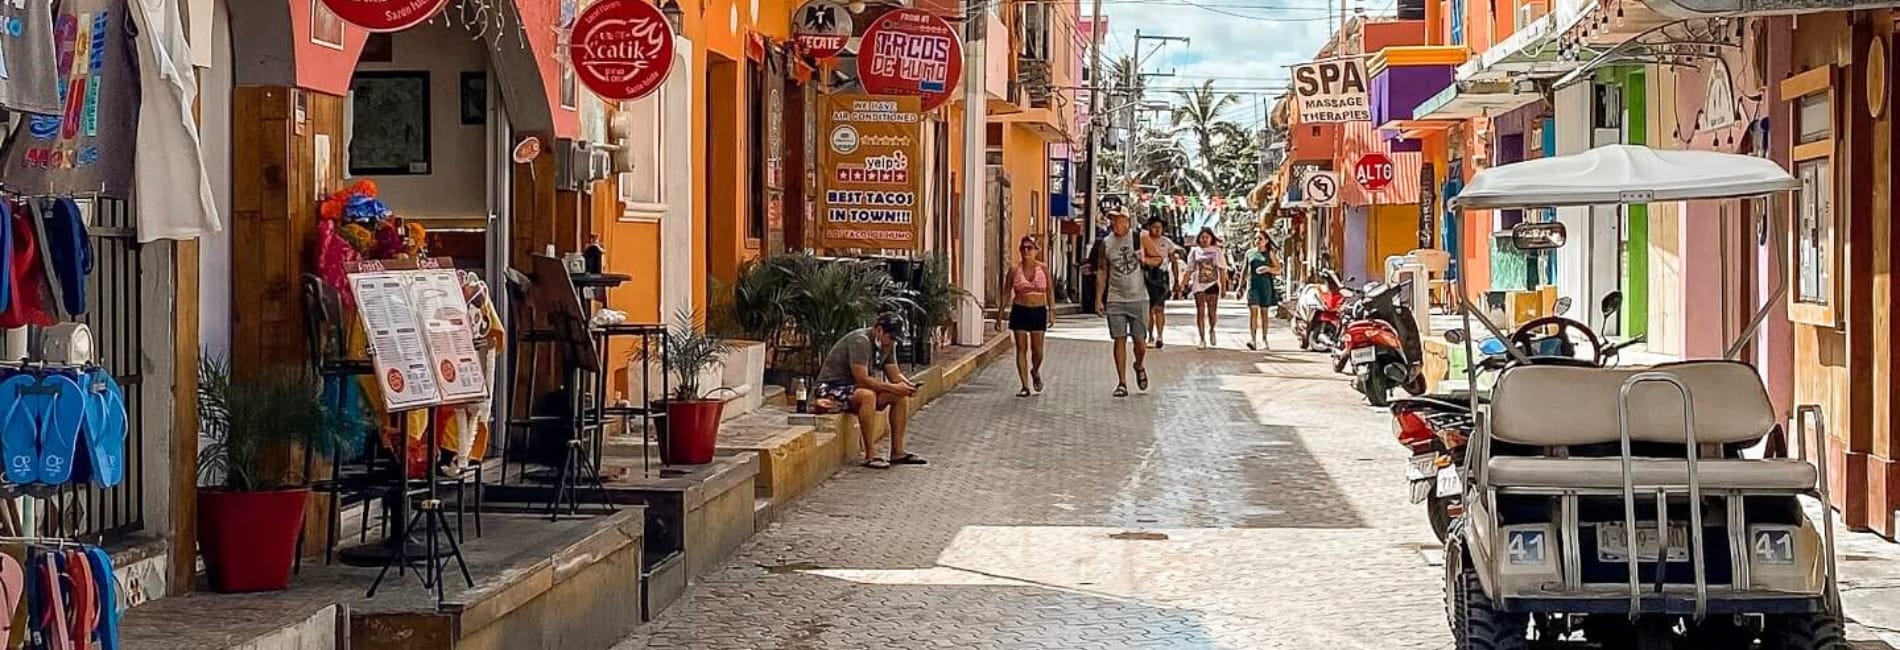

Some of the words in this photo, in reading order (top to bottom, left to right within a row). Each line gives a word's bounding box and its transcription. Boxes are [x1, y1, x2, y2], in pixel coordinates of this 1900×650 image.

[799, 36, 841, 50] TECATE
[872, 55, 896, 76] DE
[901, 58, 946, 81] HUMO
[1296, 61, 1365, 96] SPA
[1305, 97, 1362, 110] MASSAGE
[833, 112, 849, 120] AIR
[851, 112, 917, 122] CONDITIONED
[1302, 110, 1370, 122] THERAPIES
[866, 156, 893, 169] yelp
[1356, 164, 1393, 184] ALTO
[828, 191, 862, 203] BEST
[866, 193, 913, 205] TACOS
[829, 210, 845, 221] IN
[851, 210, 911, 222] TOWN!!!
[1509, 533, 1544, 560] 41
[1756, 532, 1793, 560] 41
